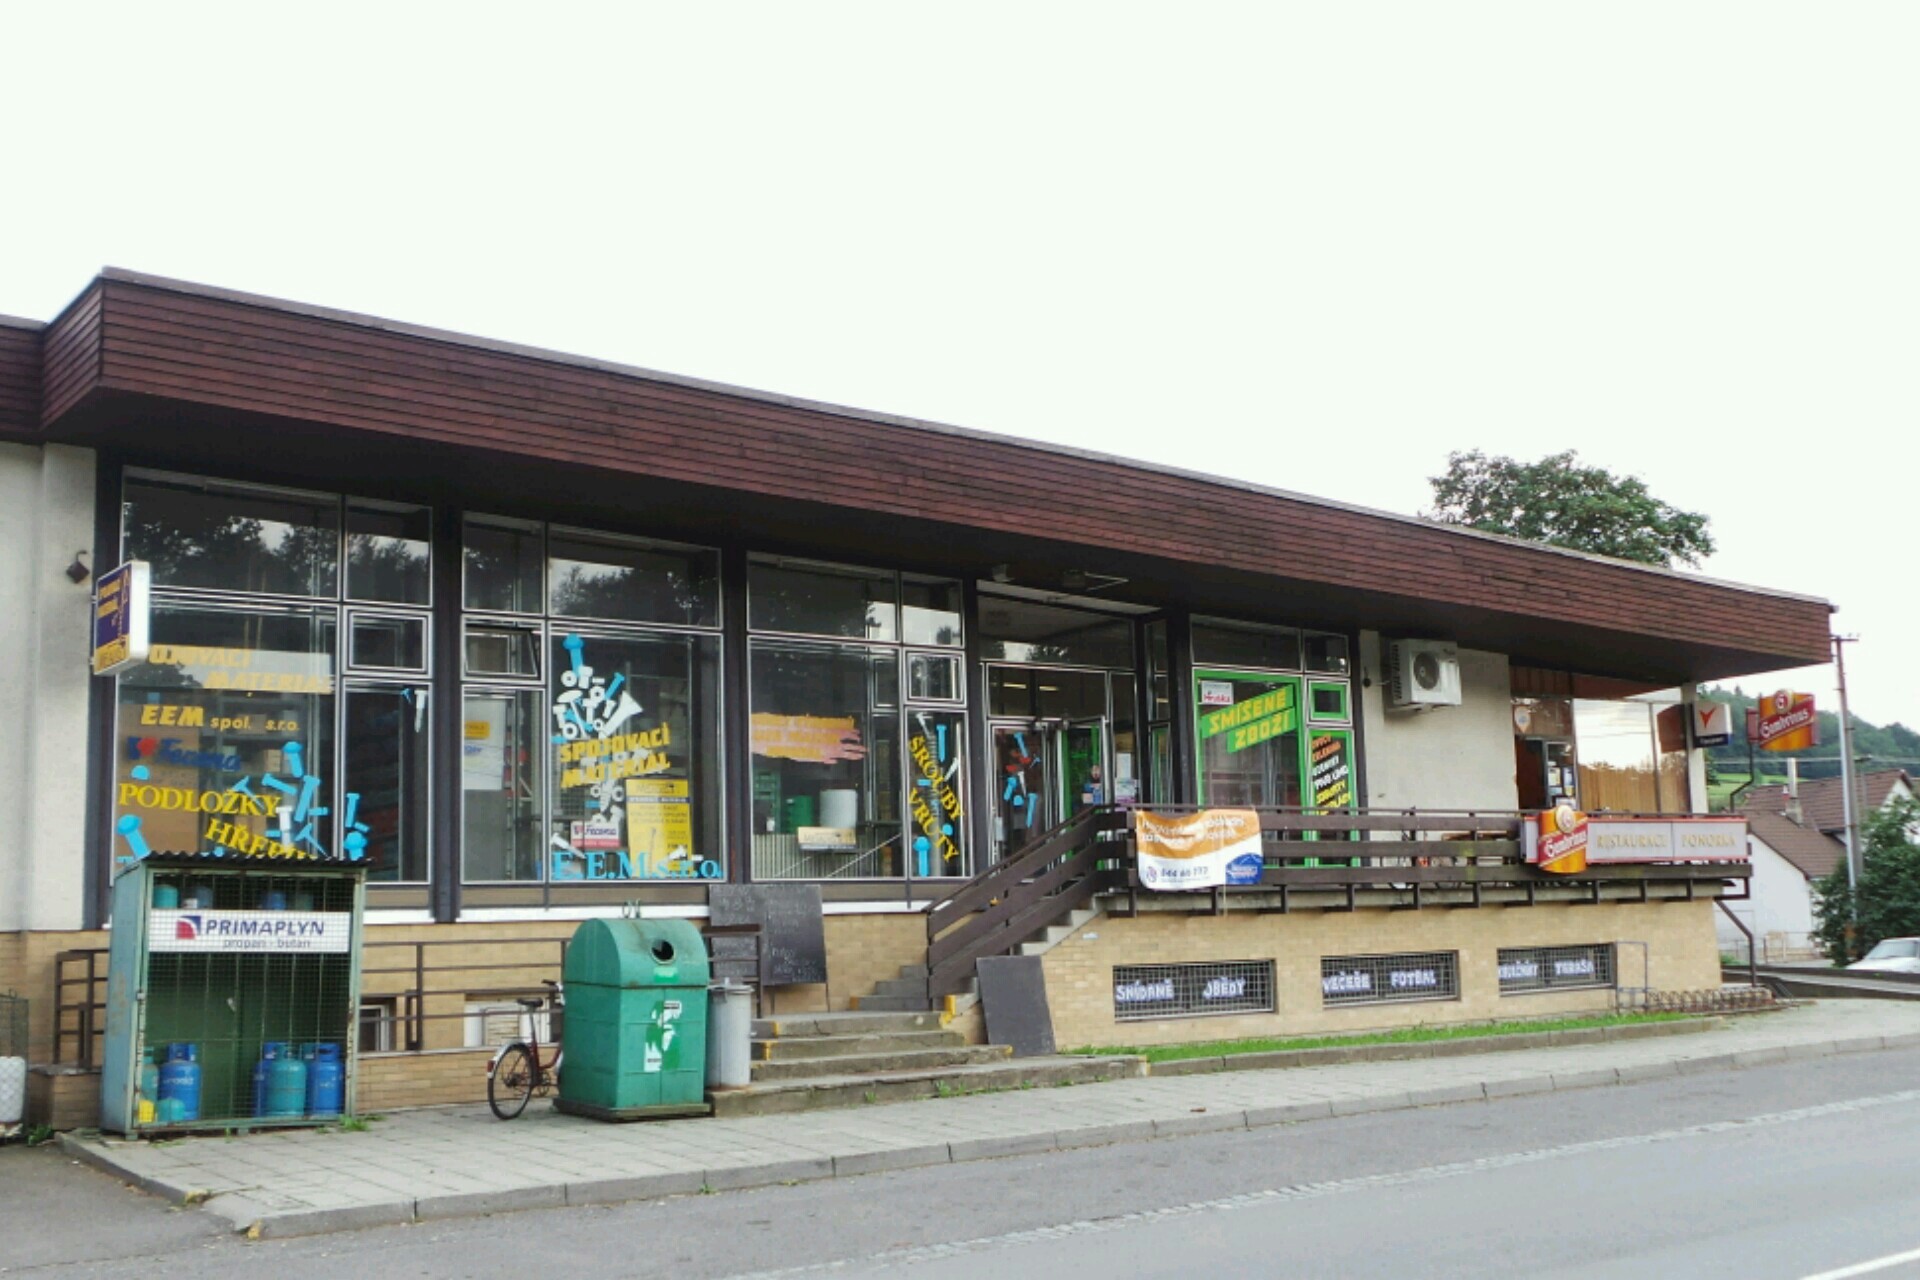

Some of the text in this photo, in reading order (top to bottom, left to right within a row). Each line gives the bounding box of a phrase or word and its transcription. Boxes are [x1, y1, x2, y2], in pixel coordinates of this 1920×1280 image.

[141, 704, 203, 727] EEM
[210, 715, 251, 731] spol.
[118, 783, 282, 817] PODLOŽKY
[205, 918, 324, 937] PRIMAPLYN
